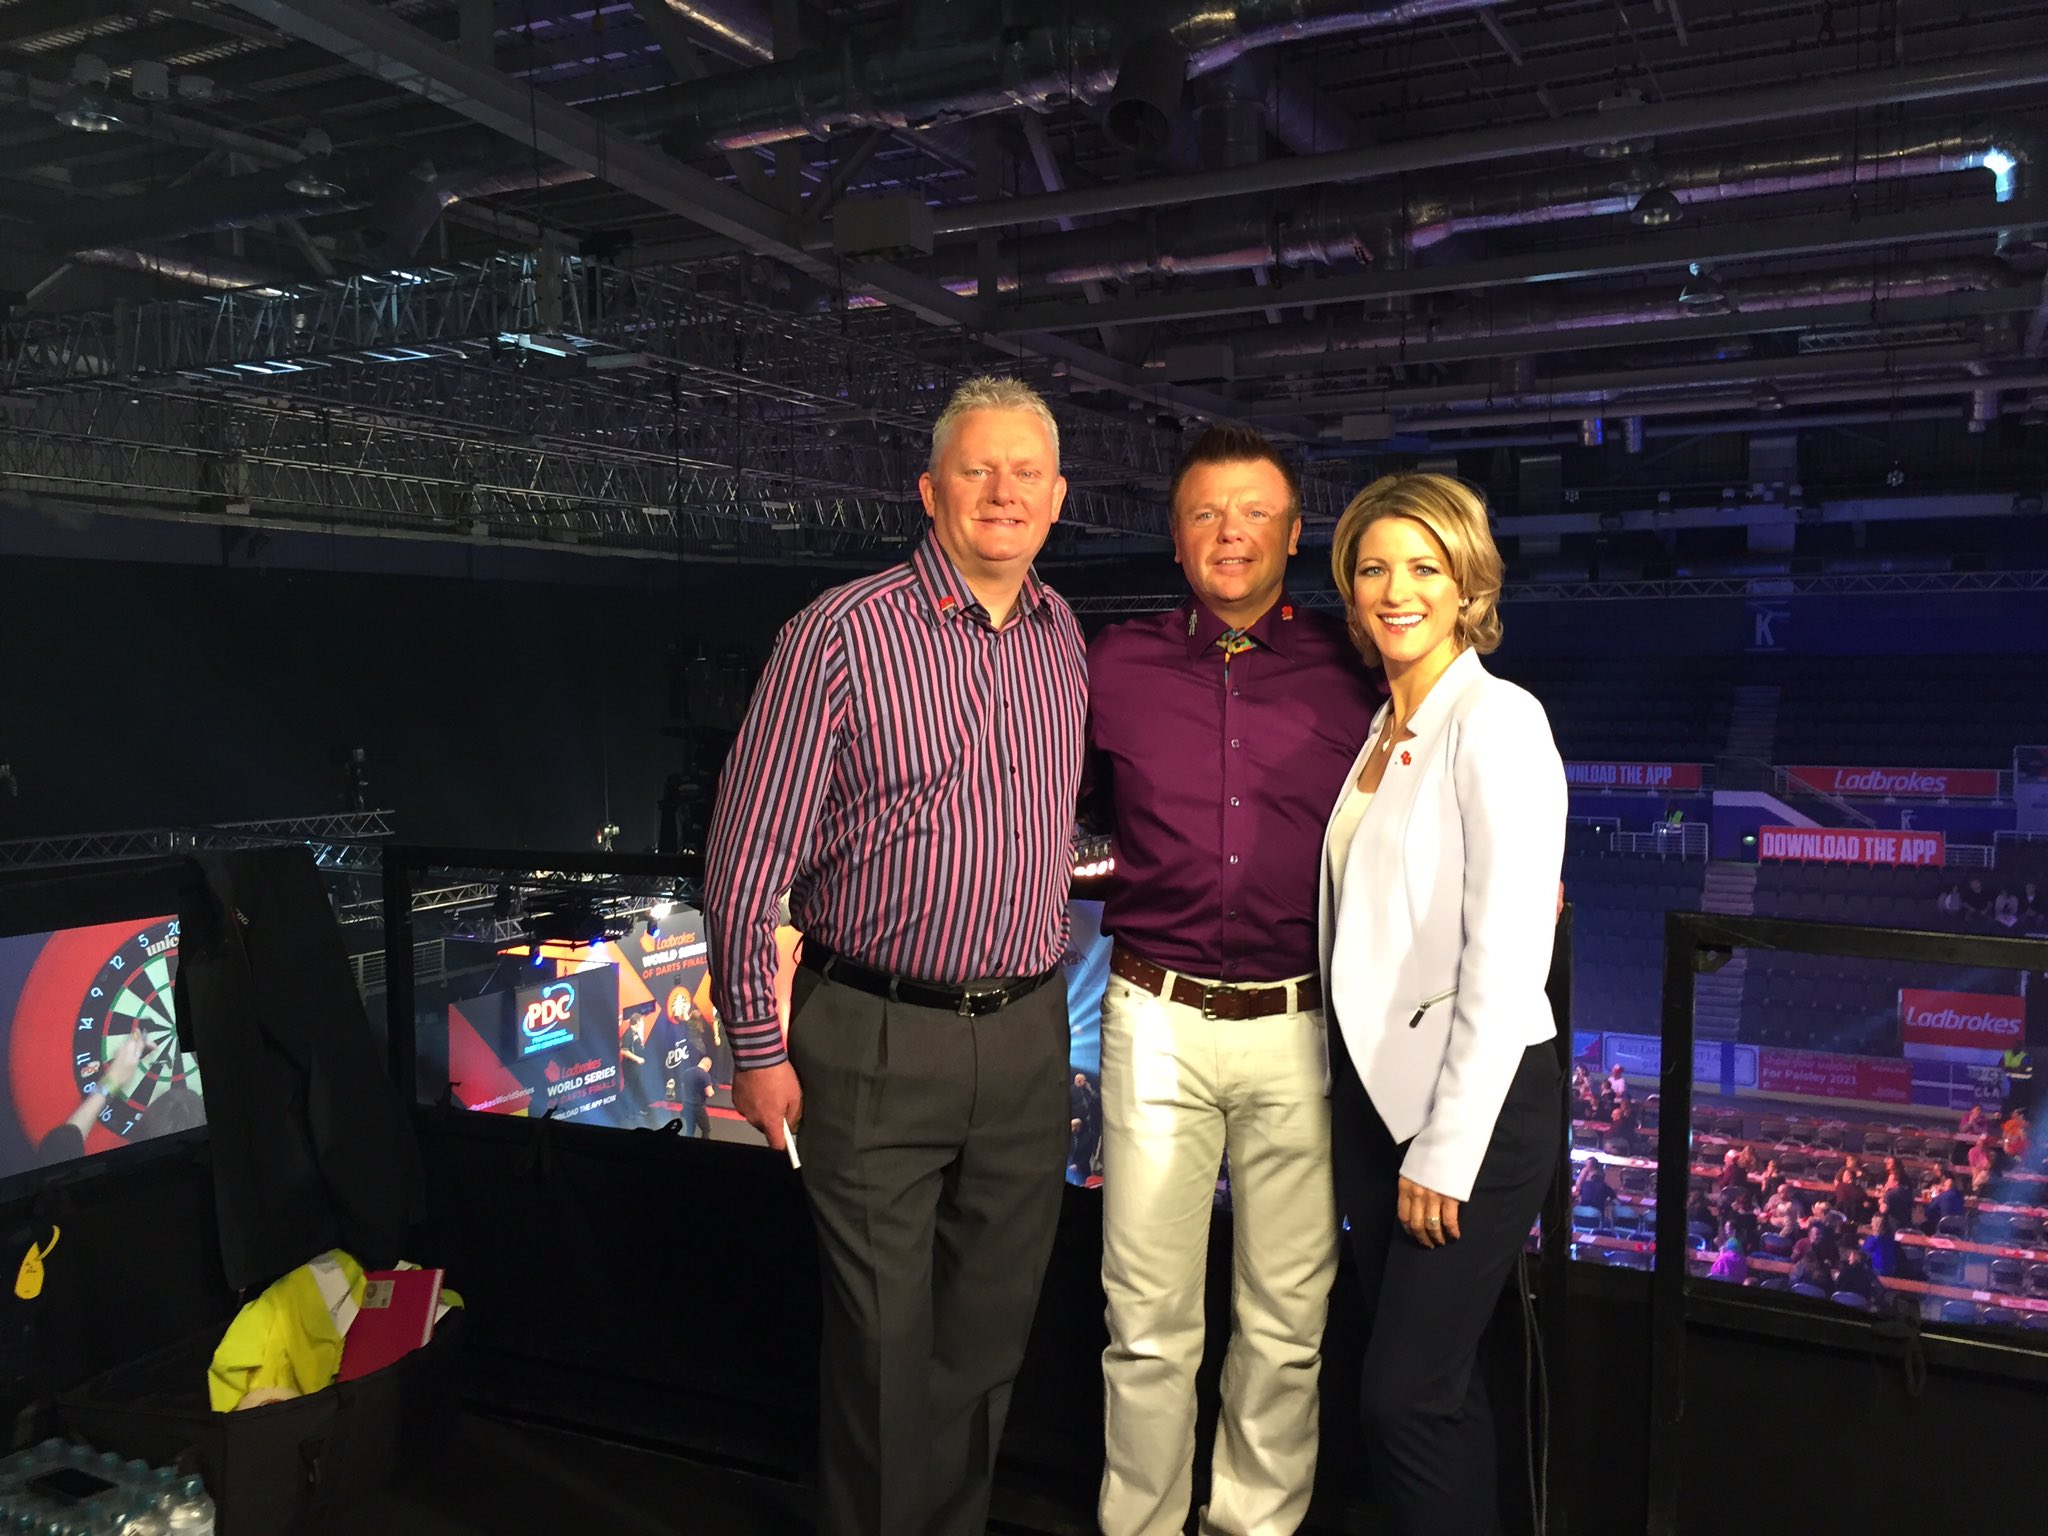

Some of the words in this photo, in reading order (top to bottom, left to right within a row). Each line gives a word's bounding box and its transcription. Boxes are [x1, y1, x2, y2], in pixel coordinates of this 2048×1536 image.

[1620, 765, 1643, 785] THE
[1645, 766, 1673, 785] APP
[1834, 769, 1947, 792] Ladbrokes
[1762, 832, 1860, 861] DOWNLOAD
[1863, 836, 1897, 861] THE
[1900, 838, 1937, 864] APP
[138, 934, 149, 947] 5
[657, 932, 696, 951] Ladbrokes
[109, 956, 125, 970] 12
[642, 949, 678, 968] WORLD
[643, 969, 654, 979] OF
[656, 962, 681, 976] DARTS
[91, 987, 104, 999] 9
[528, 994, 571, 1030] PDC
[1906, 1006, 2021, 1035] Ladbrokes
[79, 1017, 94, 1031] 14
[667, 1045, 690, 1065] PDC
[561, 1058, 602, 1079] Ladbrokes
[1763, 1067, 1782, 1079] For
[1785, 1069, 1827, 1085] Paisley
[1830, 1073, 1857, 1086] 2021
[547, 1077, 583, 1097] WORLD
[584, 1066, 616, 1085] SERIES
[588, 1078, 616, 1095] FINALS
[579, 1102, 591, 1113] THE
[590, 1098, 603, 1109] APP
[603, 1094, 617, 1105] NOW
[99, 1105, 113, 1122] 16
[121, 1121, 134, 1135] 7
